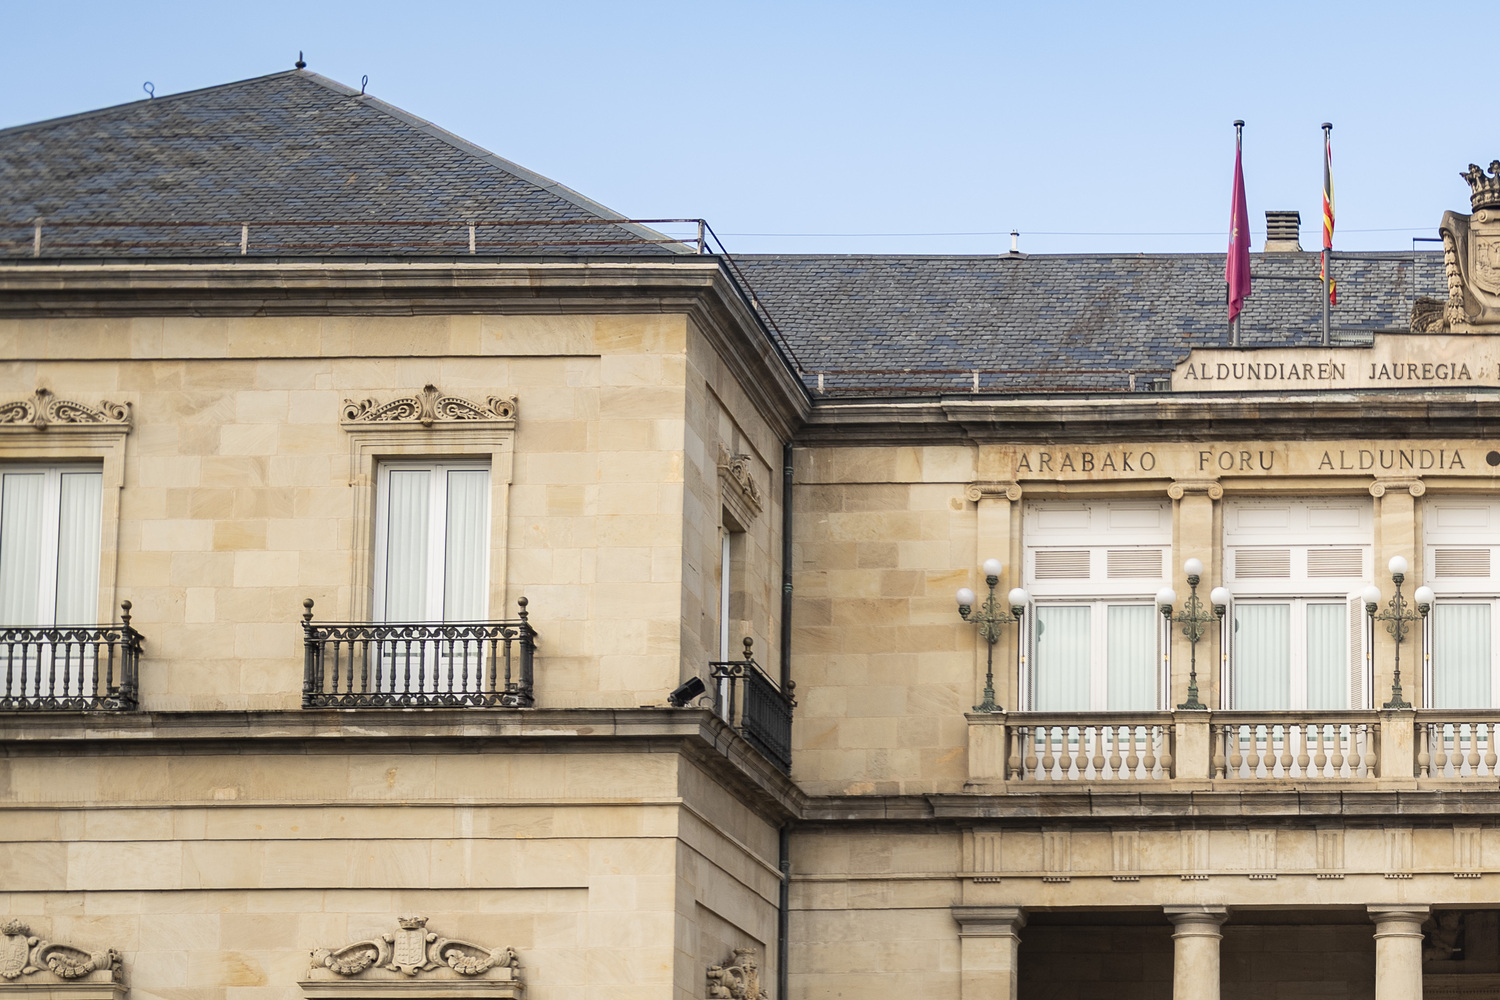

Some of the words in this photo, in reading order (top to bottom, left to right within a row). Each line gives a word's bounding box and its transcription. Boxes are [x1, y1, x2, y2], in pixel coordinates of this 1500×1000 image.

[1184, 363, 1345, 380] ALDUNDIAREN
[1369, 363, 1472, 380] JAUREGIA
[1016, 451, 1156, 472] ARABAKO
[1199, 450, 1275, 471] FORU
[1318, 449, 1466, 471] ALDUNDIA
